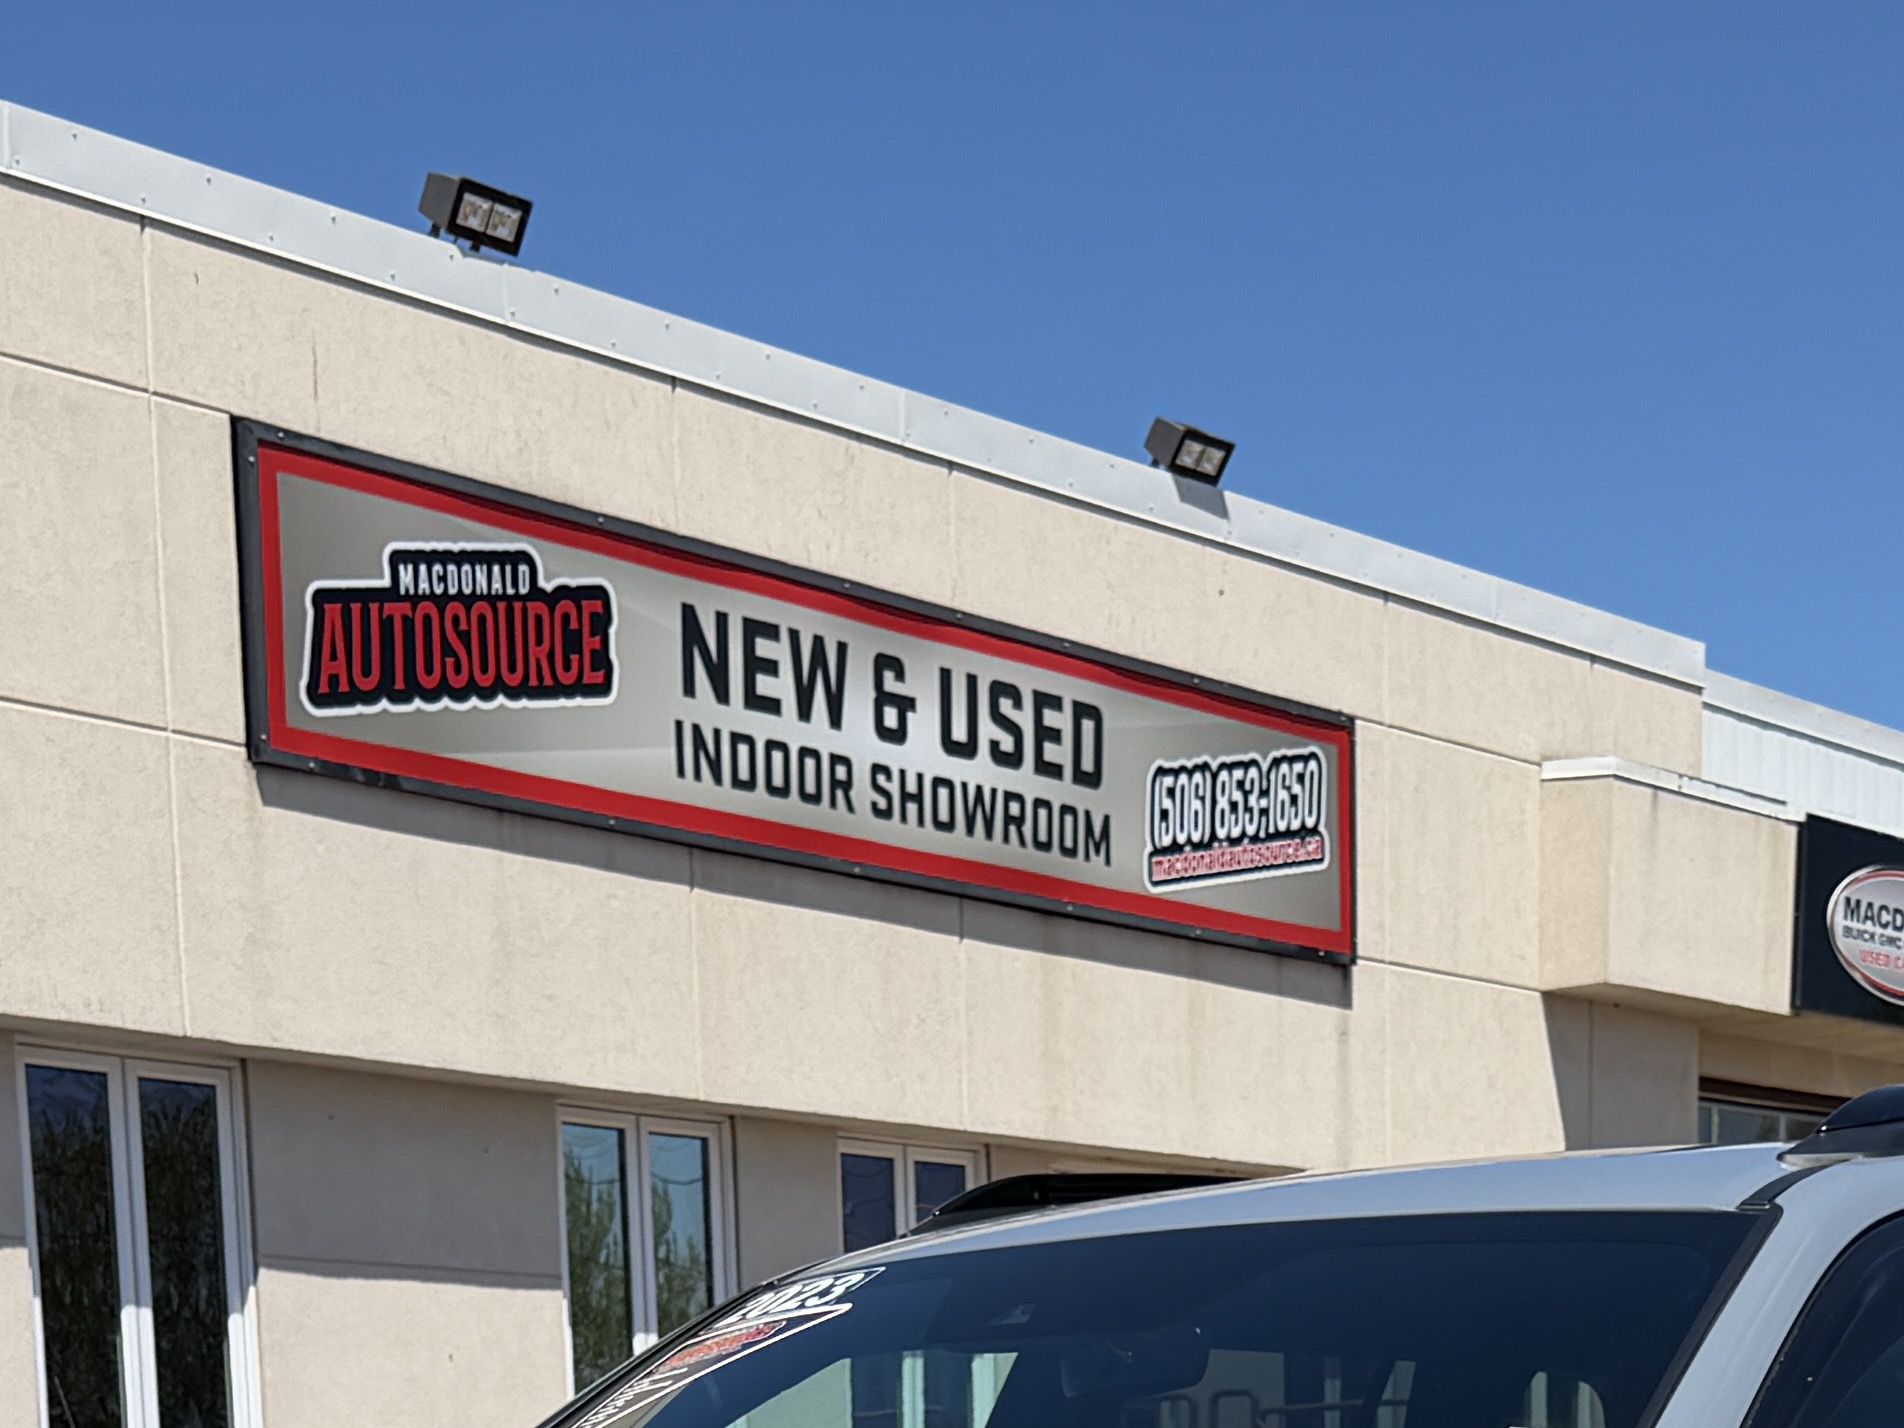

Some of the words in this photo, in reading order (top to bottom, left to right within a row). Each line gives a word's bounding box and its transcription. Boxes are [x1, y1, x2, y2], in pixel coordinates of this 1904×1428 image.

[398, 563, 531, 596] MACDONALD
[318, 599, 607, 695] AUTOSOURCE
[681, 602, 849, 731] NEW
[873, 652, 917, 746] &
[939, 666, 1104, 790] USED
[674, 719, 855, 815] INDOOR
[870, 762, 1112, 867] SHOWROOM
[1153, 770, 1211, 849] (506)
[1214, 759, 1319, 839] 853-1650
[1842, 925, 1877, 945] BUICK
[710, 1272, 866, 1330] 2023
